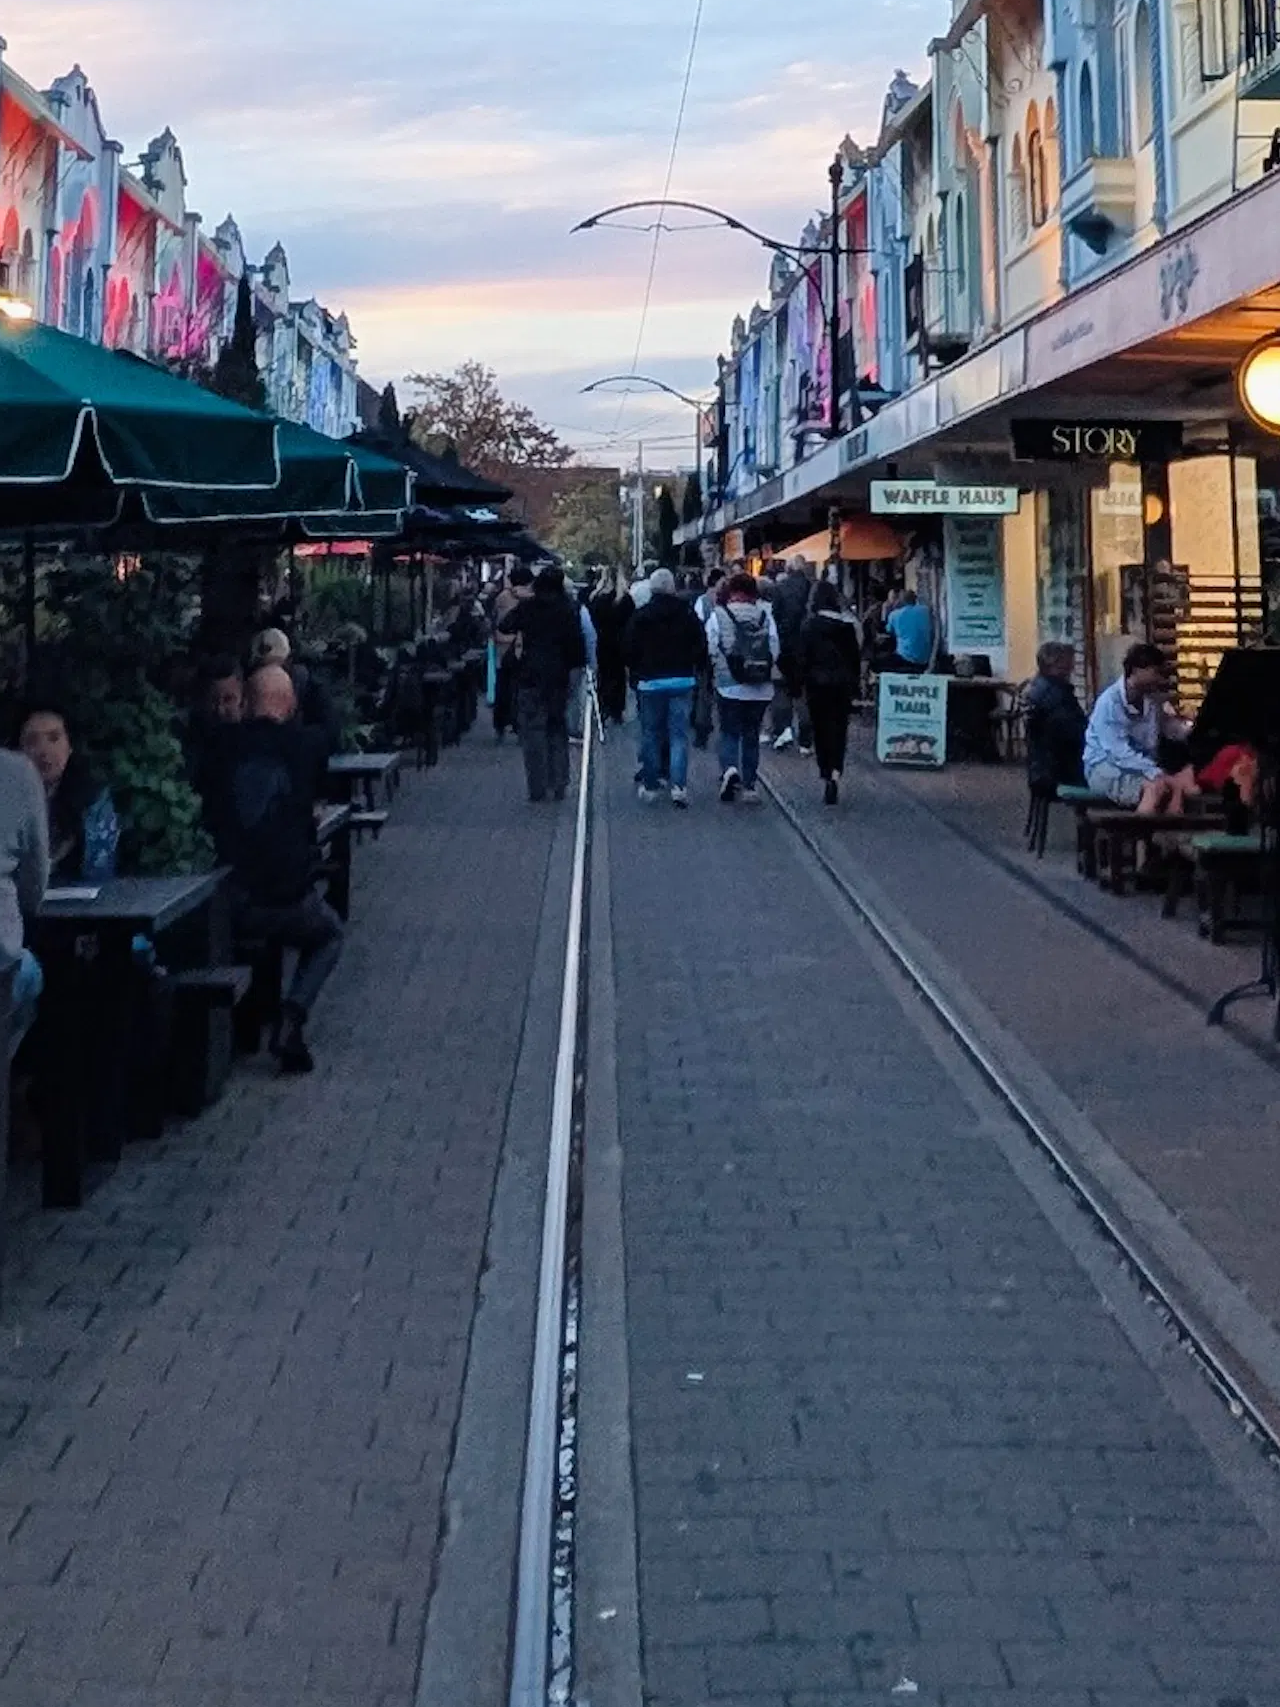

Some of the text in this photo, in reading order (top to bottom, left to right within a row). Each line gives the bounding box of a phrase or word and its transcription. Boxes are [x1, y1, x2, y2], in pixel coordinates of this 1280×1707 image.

[1051, 425, 1142, 454] STORY
[883, 488, 1007, 506] WAFFLE HAUS
